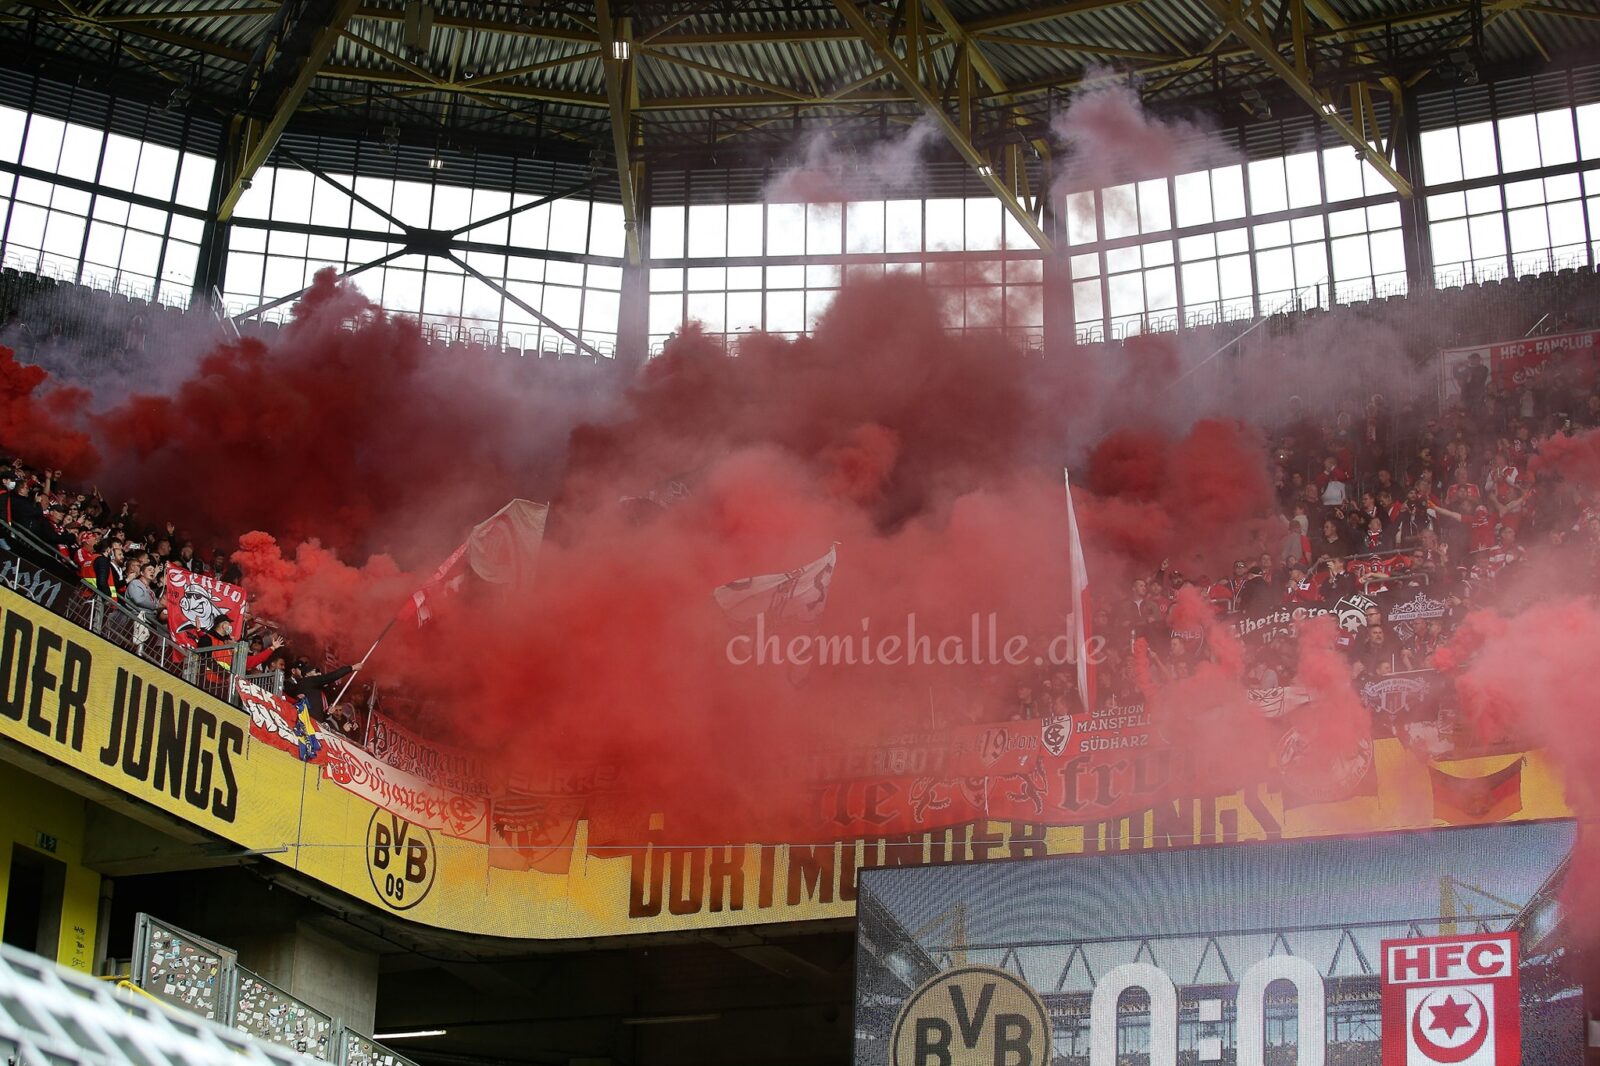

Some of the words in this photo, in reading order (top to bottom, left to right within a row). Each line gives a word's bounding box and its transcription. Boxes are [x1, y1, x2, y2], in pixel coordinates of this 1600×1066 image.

[1501, 343, 1526, 360] HFC
[1535, 335, 1593, 355] FANCLUB
[1092, 703, 1144, 719] SEKTION
[100, 667, 243, 824] JUNGS
[1080, 734, 1149, 753] SÜDHARZ
[374, 813, 428, 884] BVB
[385, 873, 404, 901] 09
[1393, 943, 1504, 982] HFC
[915, 984, 1034, 1066] BVB
